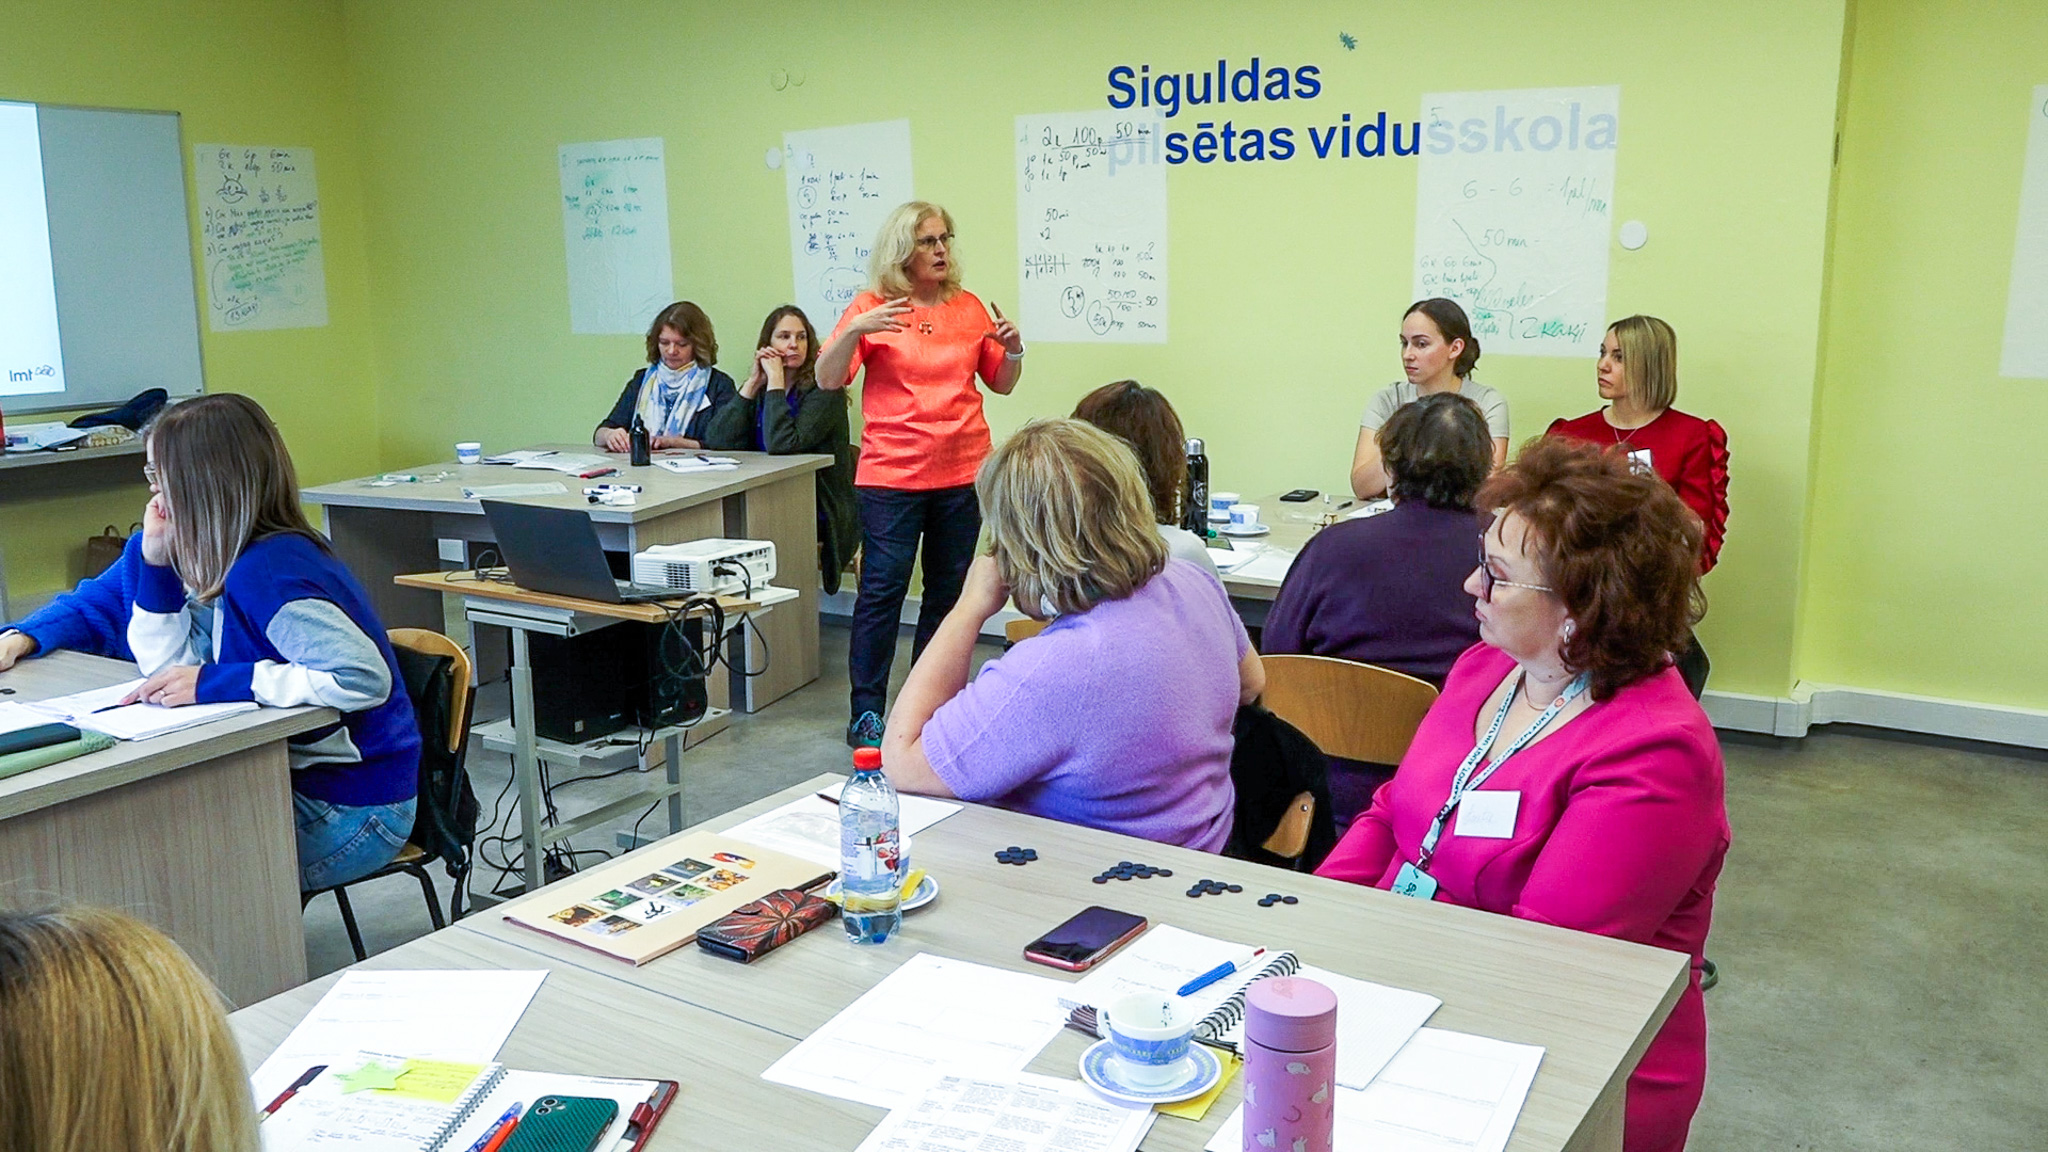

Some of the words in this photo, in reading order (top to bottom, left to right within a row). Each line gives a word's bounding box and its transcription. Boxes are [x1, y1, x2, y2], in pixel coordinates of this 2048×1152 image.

[1106, 57, 1322, 118] Siguldas
[1107, 119, 1296, 177] pilsētas
[1308, 102, 1618, 160] vidusskola
[9, 369, 32, 382] lmt
